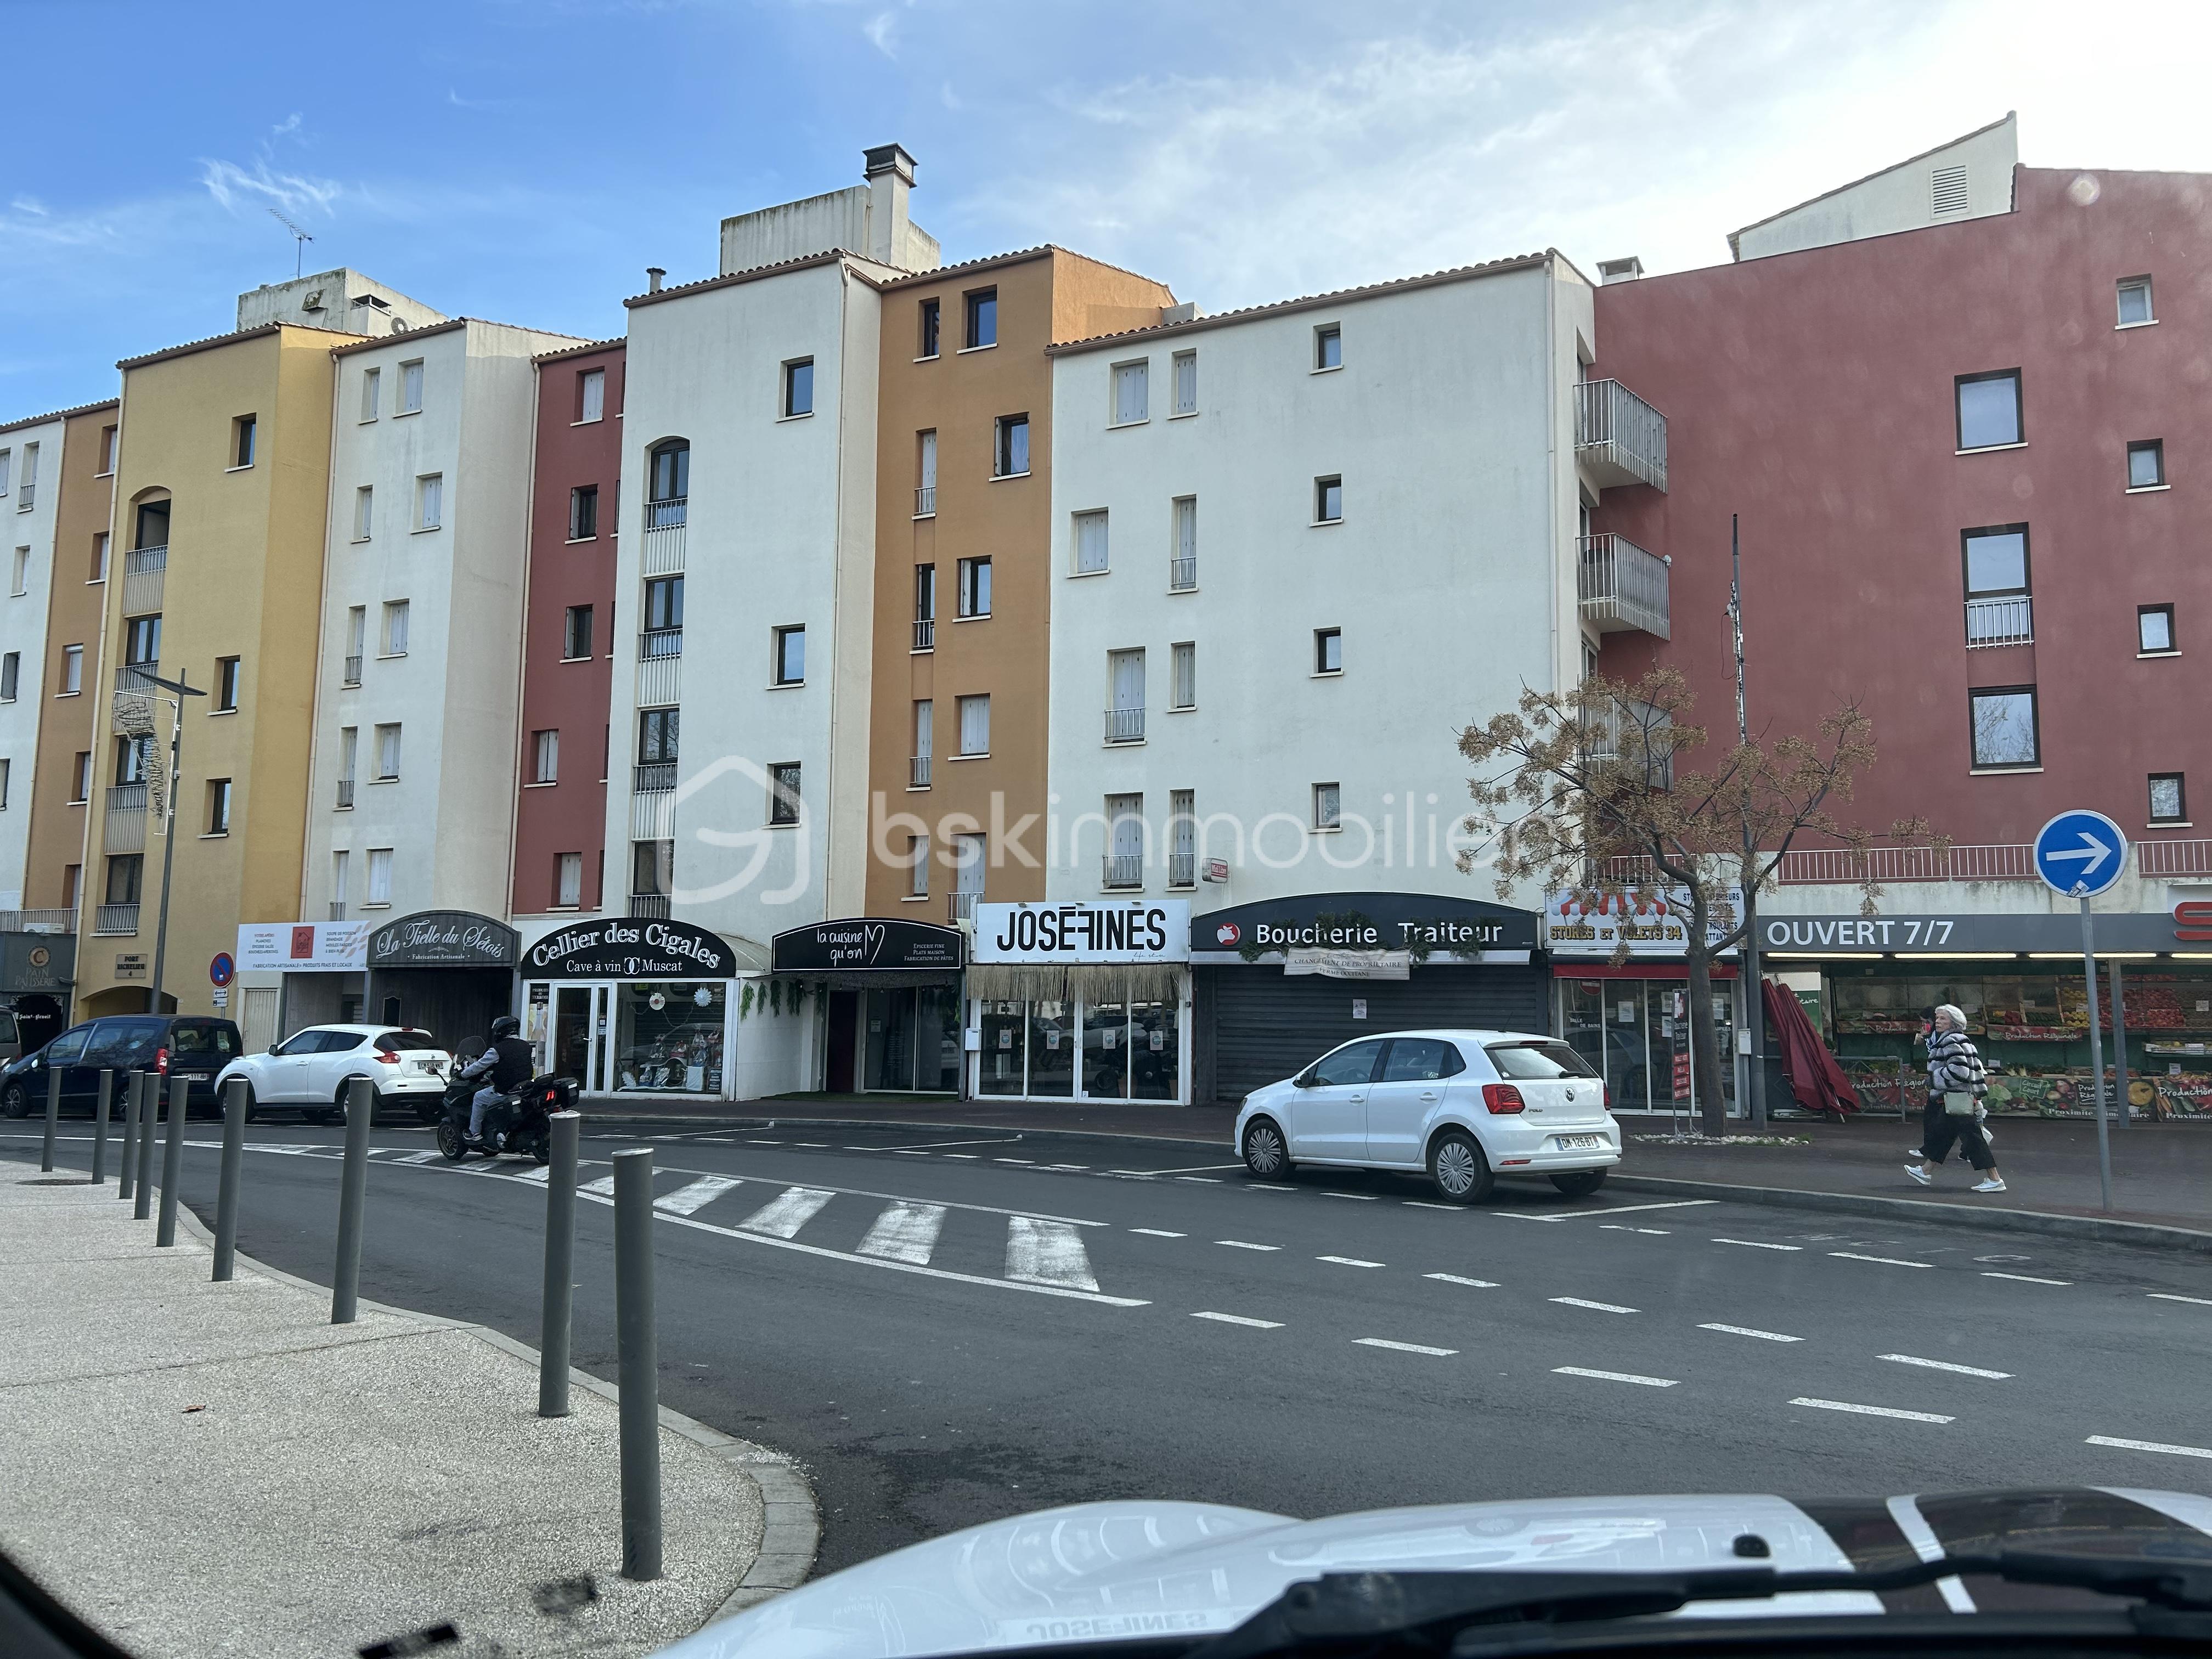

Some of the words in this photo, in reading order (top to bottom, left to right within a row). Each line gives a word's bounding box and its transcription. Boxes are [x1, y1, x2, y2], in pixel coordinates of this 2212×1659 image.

[376, 928, 400, 959] La
[403, 919, 441, 948] Tielle
[442, 925, 460, 944] du
[462, 926, 505, 958] Sétois
[817, 928, 827, 943] la
[830, 928, 863, 943] cuisine
[1257, 923, 1378, 944] Boucherie
[1398, 922, 1503, 943] Traiteur
[1600, 928, 1613, 940] ET
[1665, 926, 1682, 940] 34
[1767, 921, 1895, 945] OUVERT
[1904, 920, 1954, 946] 7/7
[533, 930, 600, 966] Cellier
[605, 922, 640, 943] des
[645, 923, 721, 969] Cigales
[830, 944, 862, 967] qu'on
[567, 960, 592, 972] Cave
[595, 960, 602, 972] à
[605, 960, 622, 972] vin
[642, 960, 683, 972] Muscat
